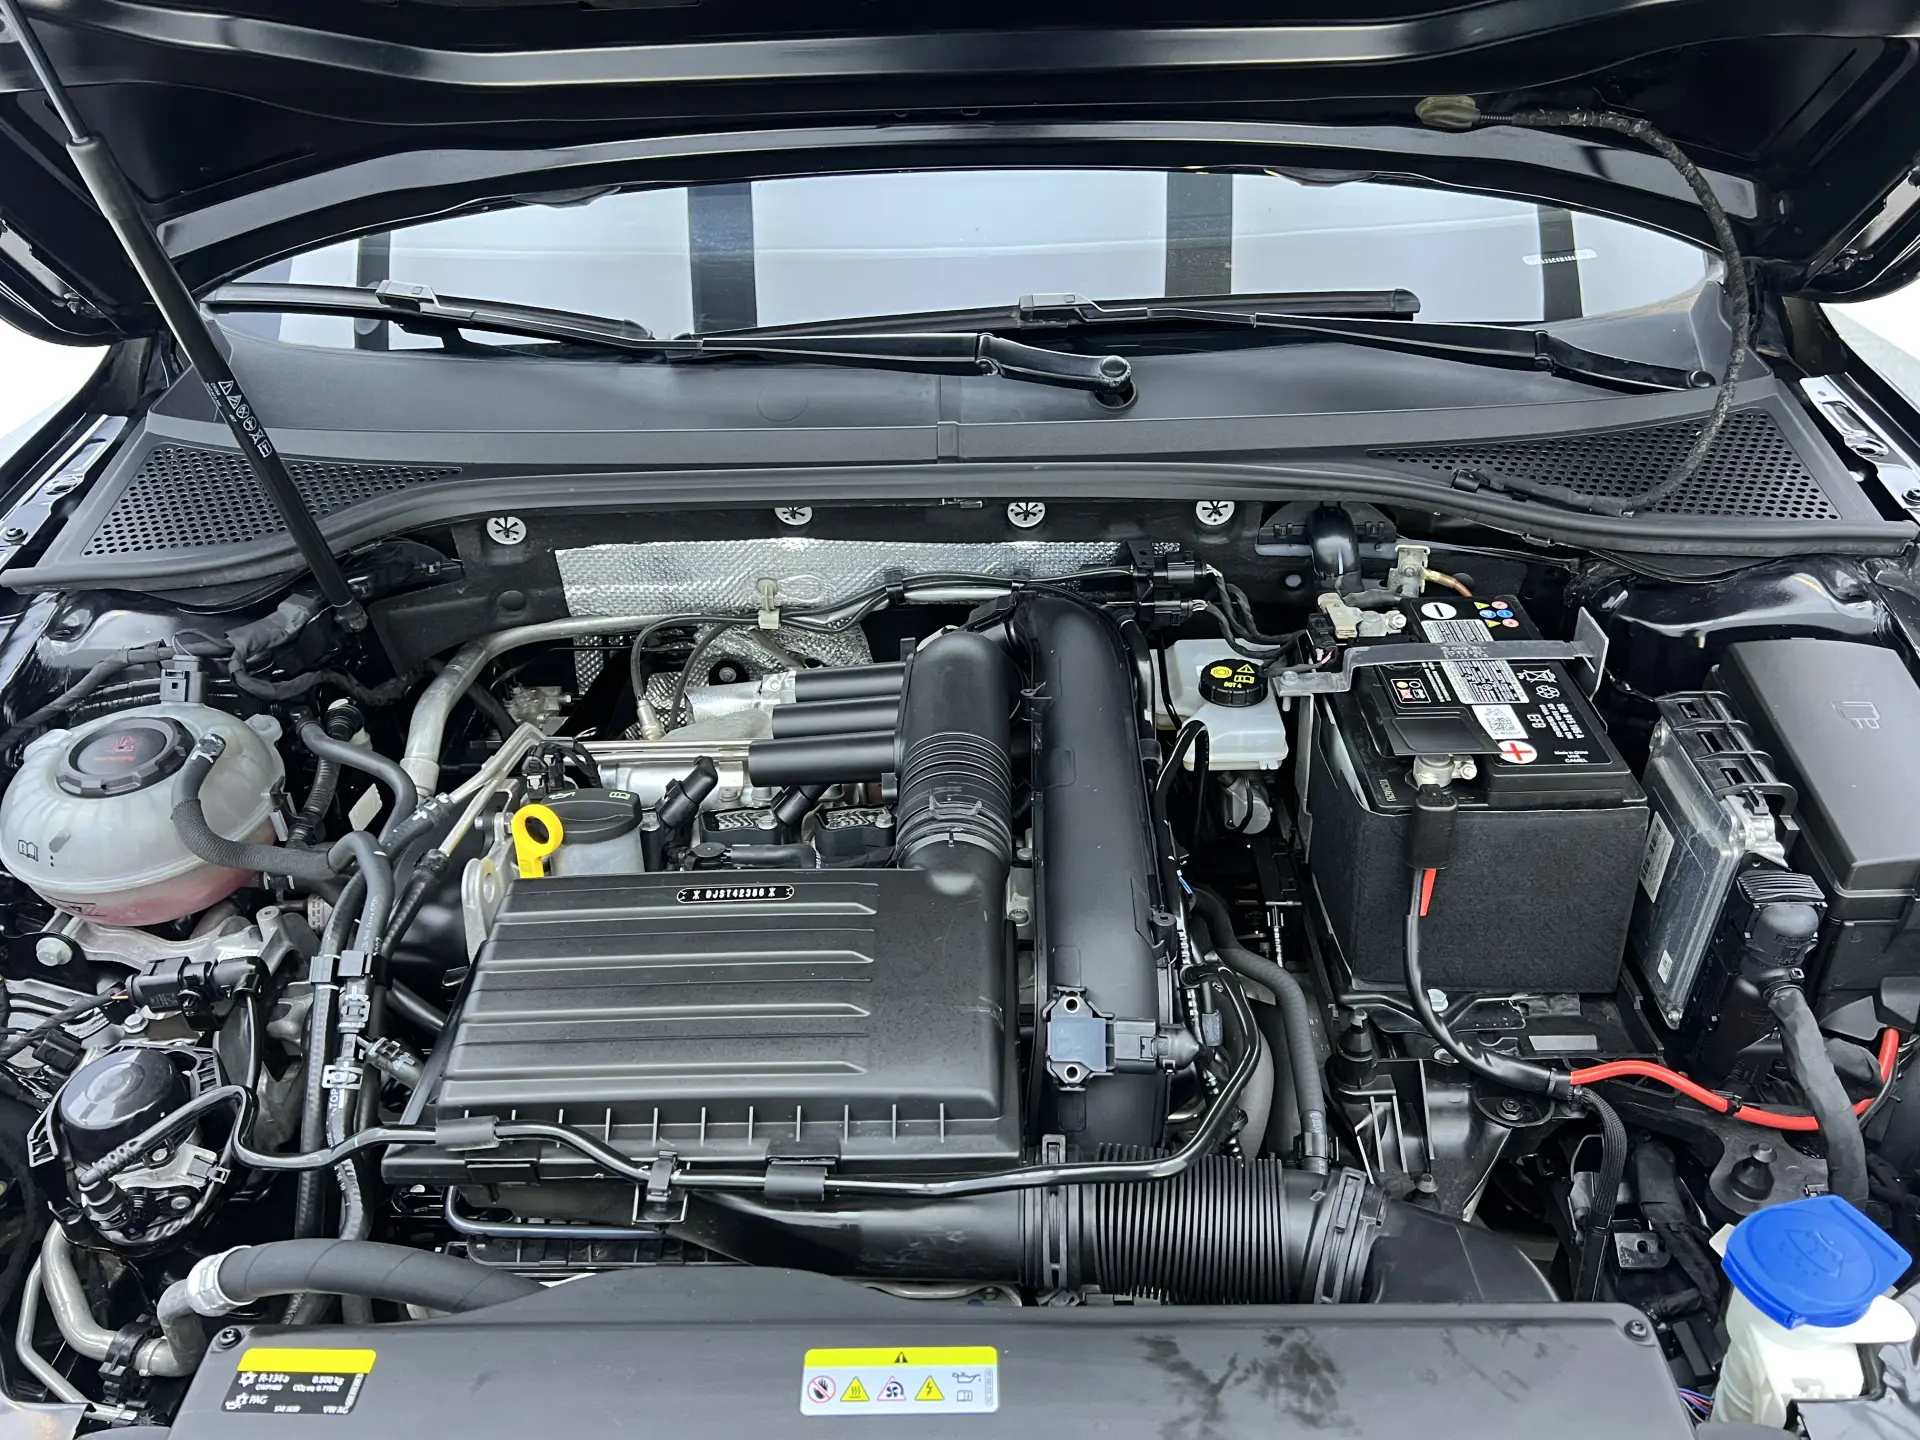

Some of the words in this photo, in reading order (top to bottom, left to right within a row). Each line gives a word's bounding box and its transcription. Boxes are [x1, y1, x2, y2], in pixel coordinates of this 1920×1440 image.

[1526, 713, 1547, 728] EFB
[328, 1088, 339, 1110] TOP
[311, 1374, 334, 1384] 0.500
[334, 1375, 345, 1387] kg
[248, 1394, 269, 1405] PAG
[322, 1405, 337, 1414] VW
[336, 1405, 349, 1415] AG
